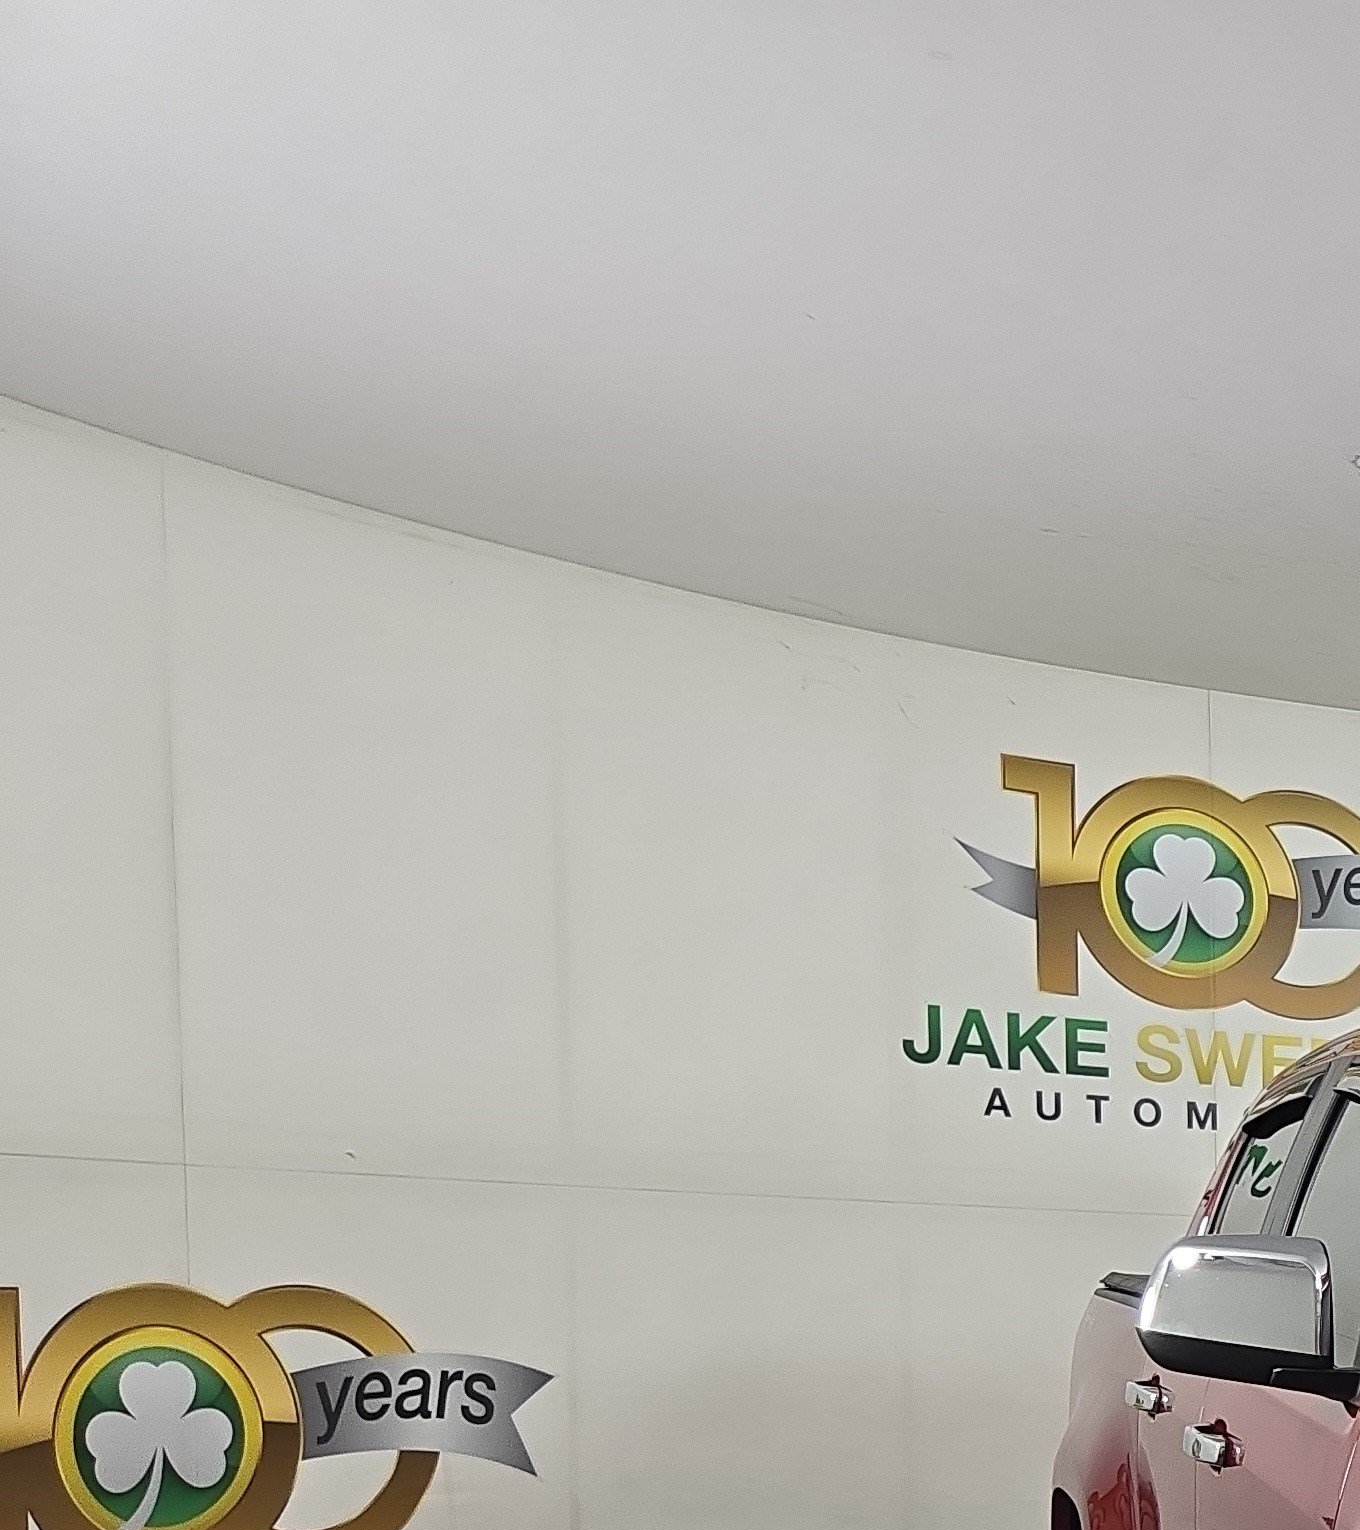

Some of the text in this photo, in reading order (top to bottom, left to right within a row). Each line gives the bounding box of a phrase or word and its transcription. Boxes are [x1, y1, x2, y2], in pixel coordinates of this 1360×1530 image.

[902, 1004, 1109, 1078] JAKE
[983, 1087, 1218, 1131] AUTOM
[315, 1368, 497, 1446] years
